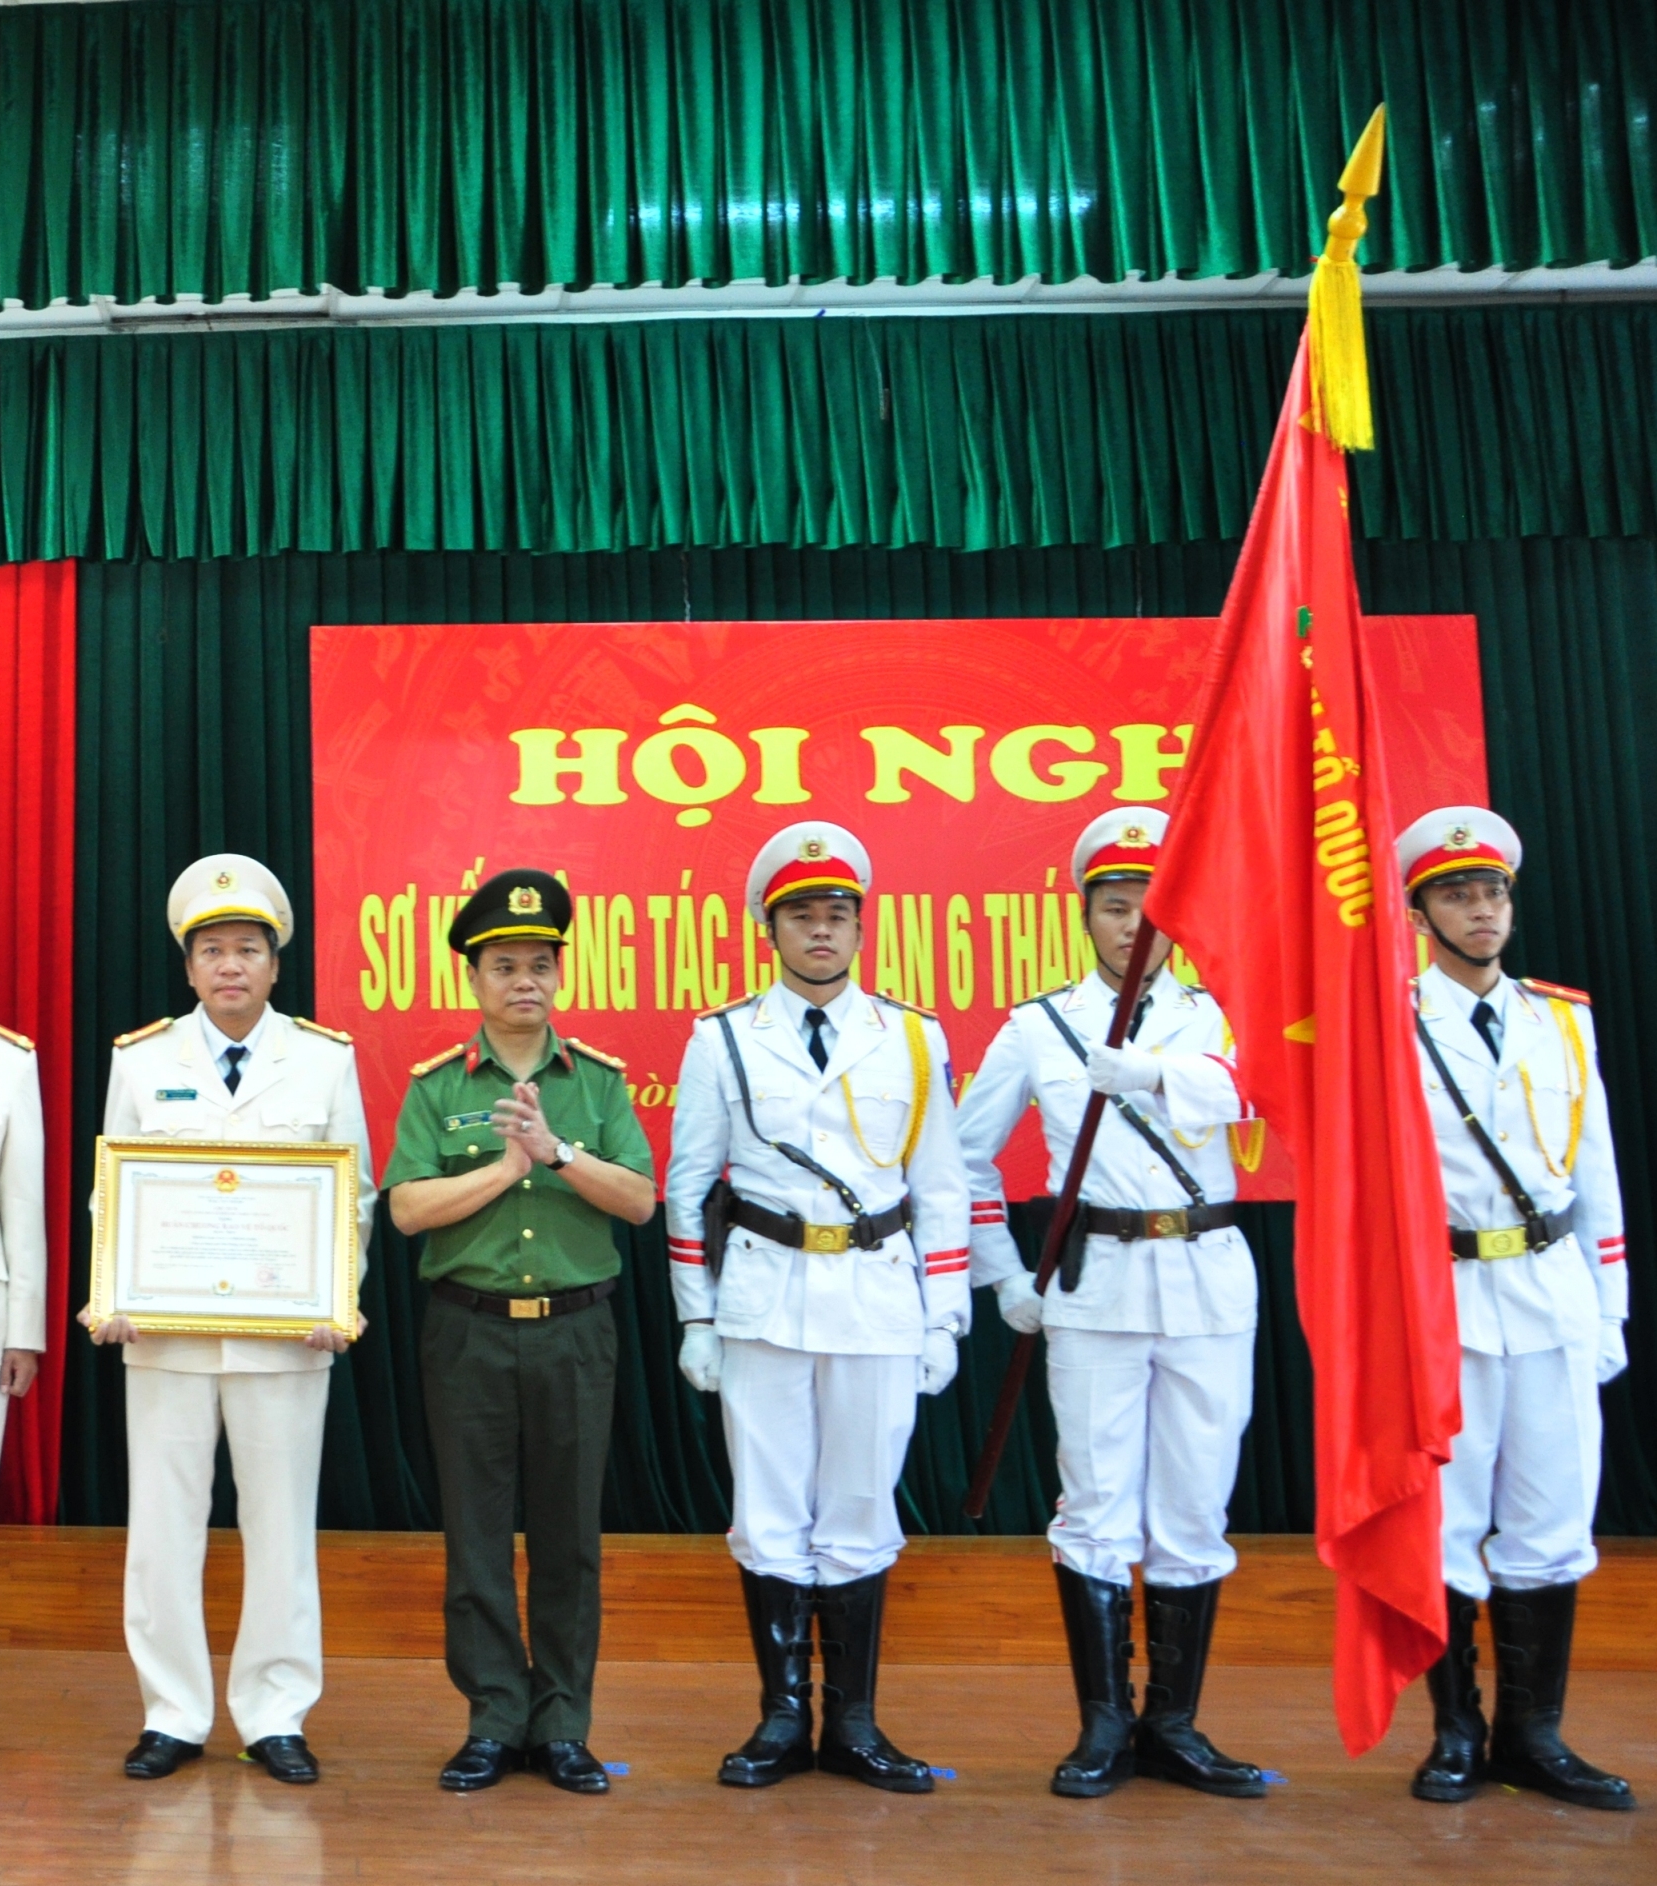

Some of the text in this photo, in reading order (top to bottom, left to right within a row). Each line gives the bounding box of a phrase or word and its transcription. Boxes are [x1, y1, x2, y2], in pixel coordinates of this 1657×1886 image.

[508, 703, 1195, 828] HỘI NGH
[359, 883, 418, 1012] SƠ
[647, 869, 730, 1011] TÁC
[874, 893, 936, 1010] AN
[945, 893, 975, 1012] 6
[983, 866, 1098, 1009] THÁN
